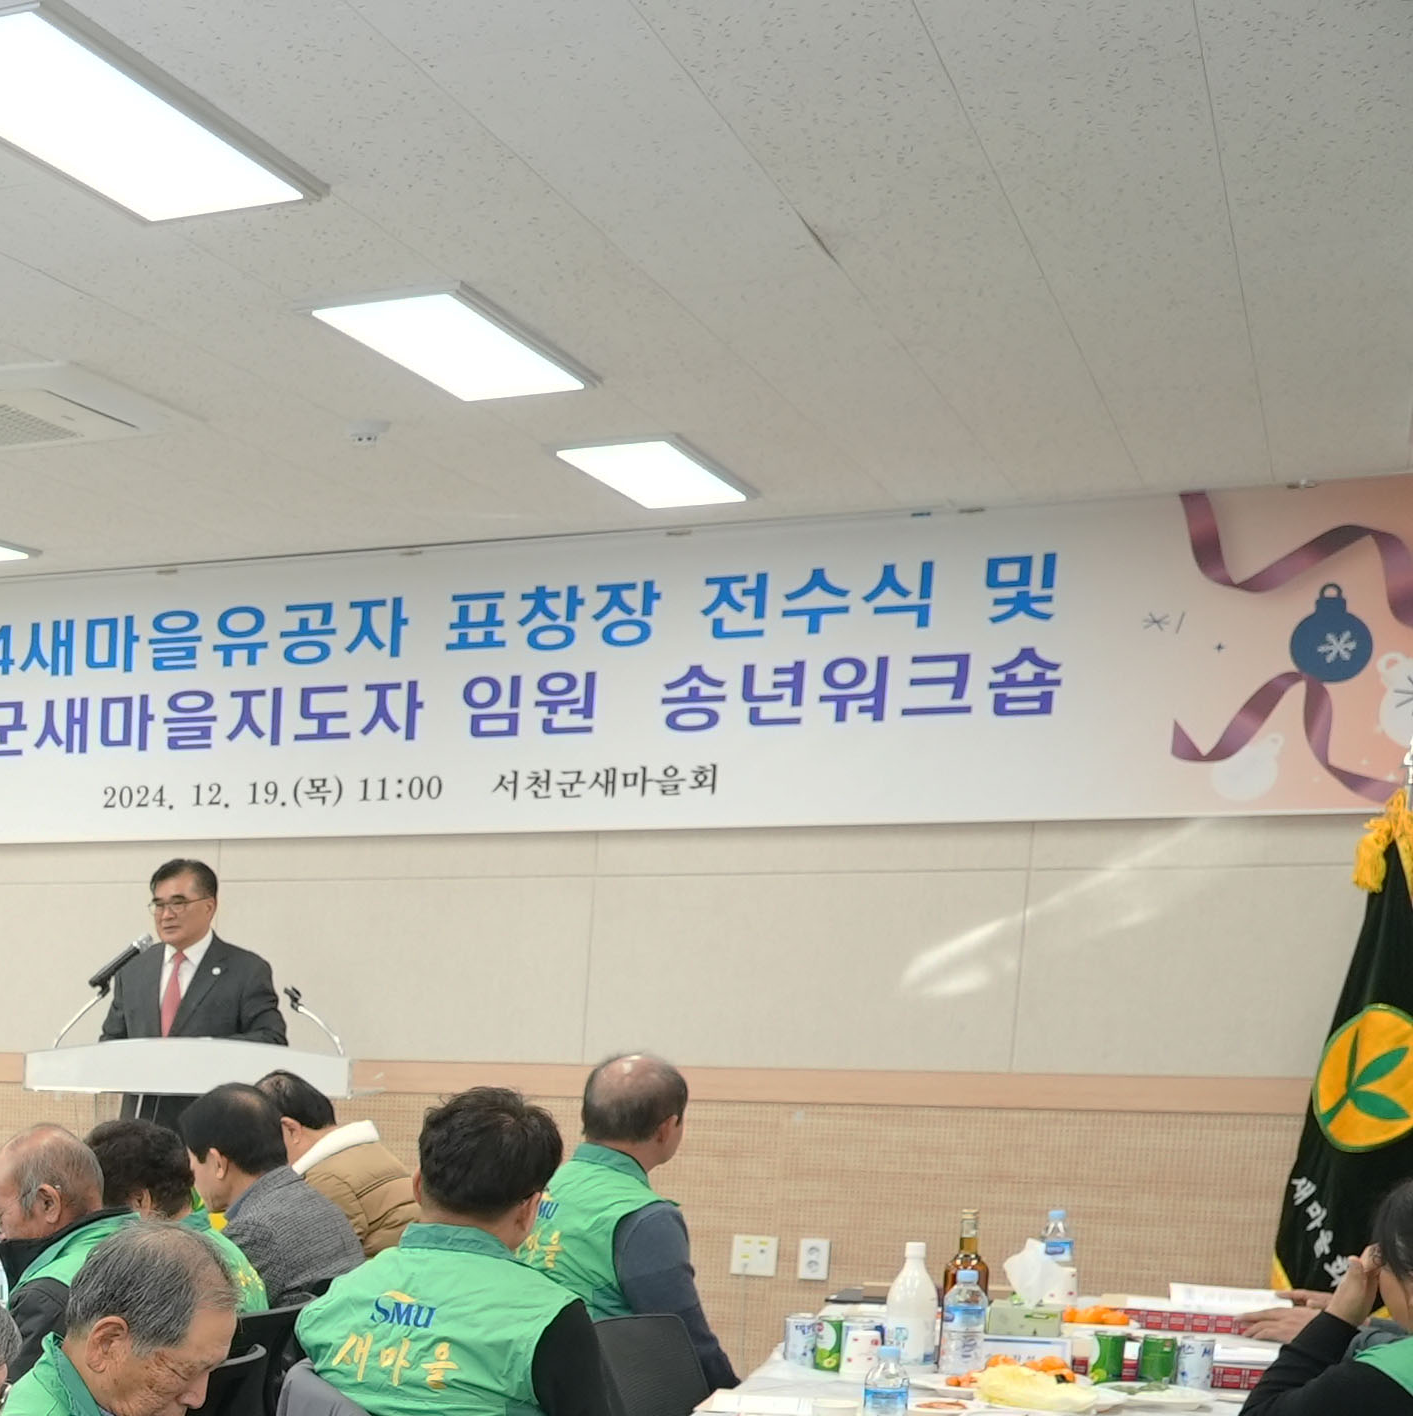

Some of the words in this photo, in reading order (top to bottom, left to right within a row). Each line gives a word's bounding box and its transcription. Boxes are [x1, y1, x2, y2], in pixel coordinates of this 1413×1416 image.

[445, 579, 661, 652] 표창장
[700, 559, 935, 639] 전수식
[985, 552, 1057, 624] 및
[462, 671, 597, 738] 임원
[661, 646, 1063, 732] 송년워크숍
[103, 786, 174, 811] 2024.
[193, 782, 230, 808] 12.
[359, 775, 443, 802] 11:00
[492, 763, 719, 802] 서천군새마을회
[538, 1200, 559, 1220] MU
[370, 1291, 436, 1329] SMU
[332, 1332, 459, 1390] 새마을
